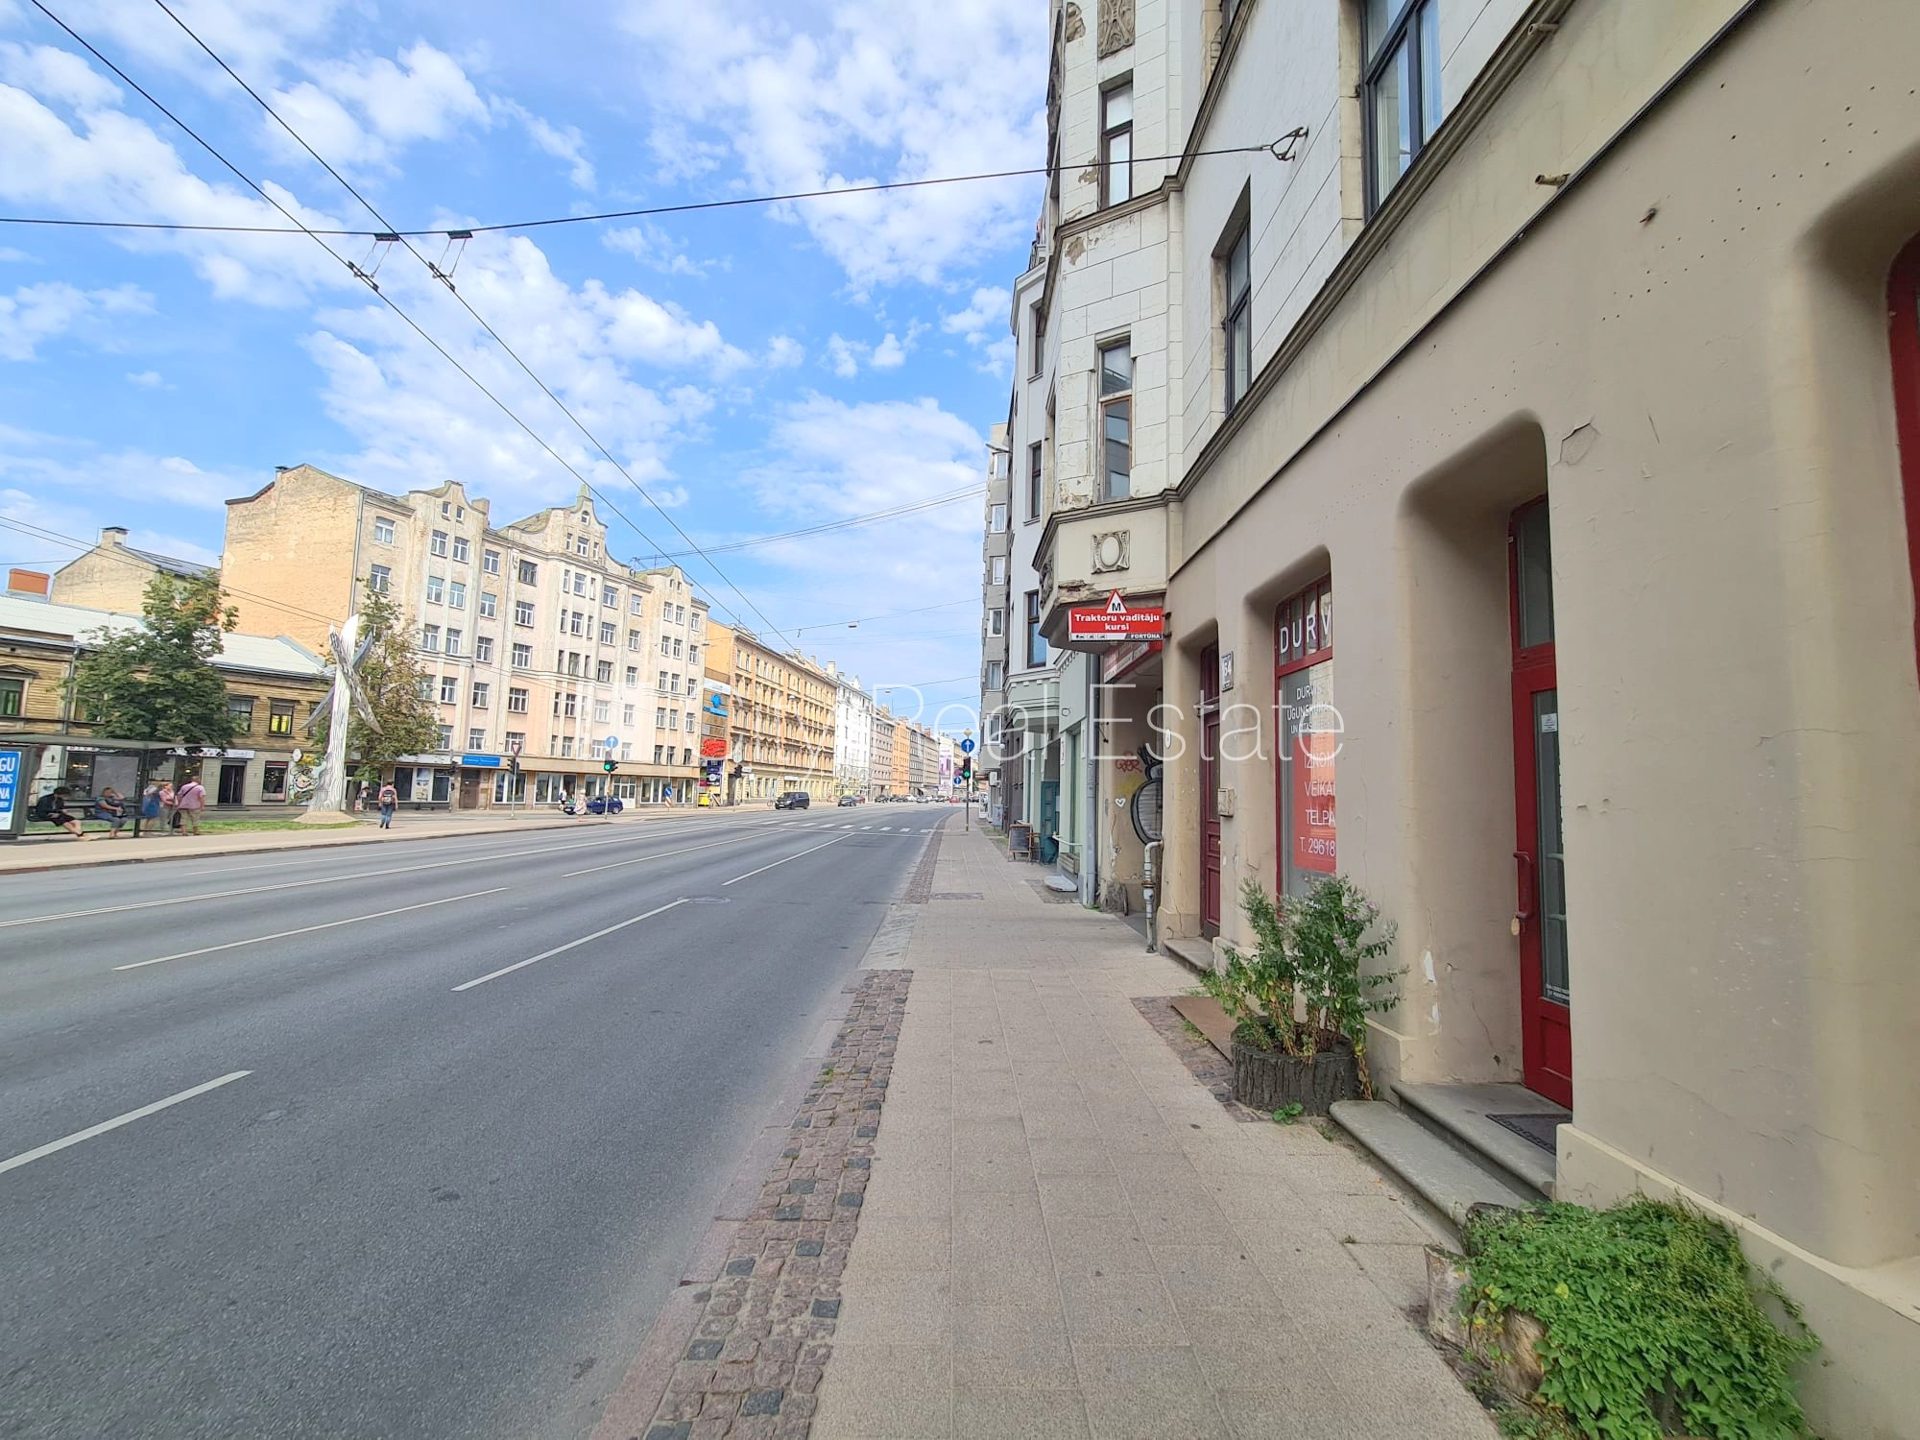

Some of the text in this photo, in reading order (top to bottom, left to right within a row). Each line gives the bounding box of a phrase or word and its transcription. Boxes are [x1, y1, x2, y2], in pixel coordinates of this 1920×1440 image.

[1112, 602, 1121, 612] M
[1075, 614, 1117, 622] Traktoru
[1105, 623, 1130, 631] kursi
[1307, 837, 1335, 857] 29618
